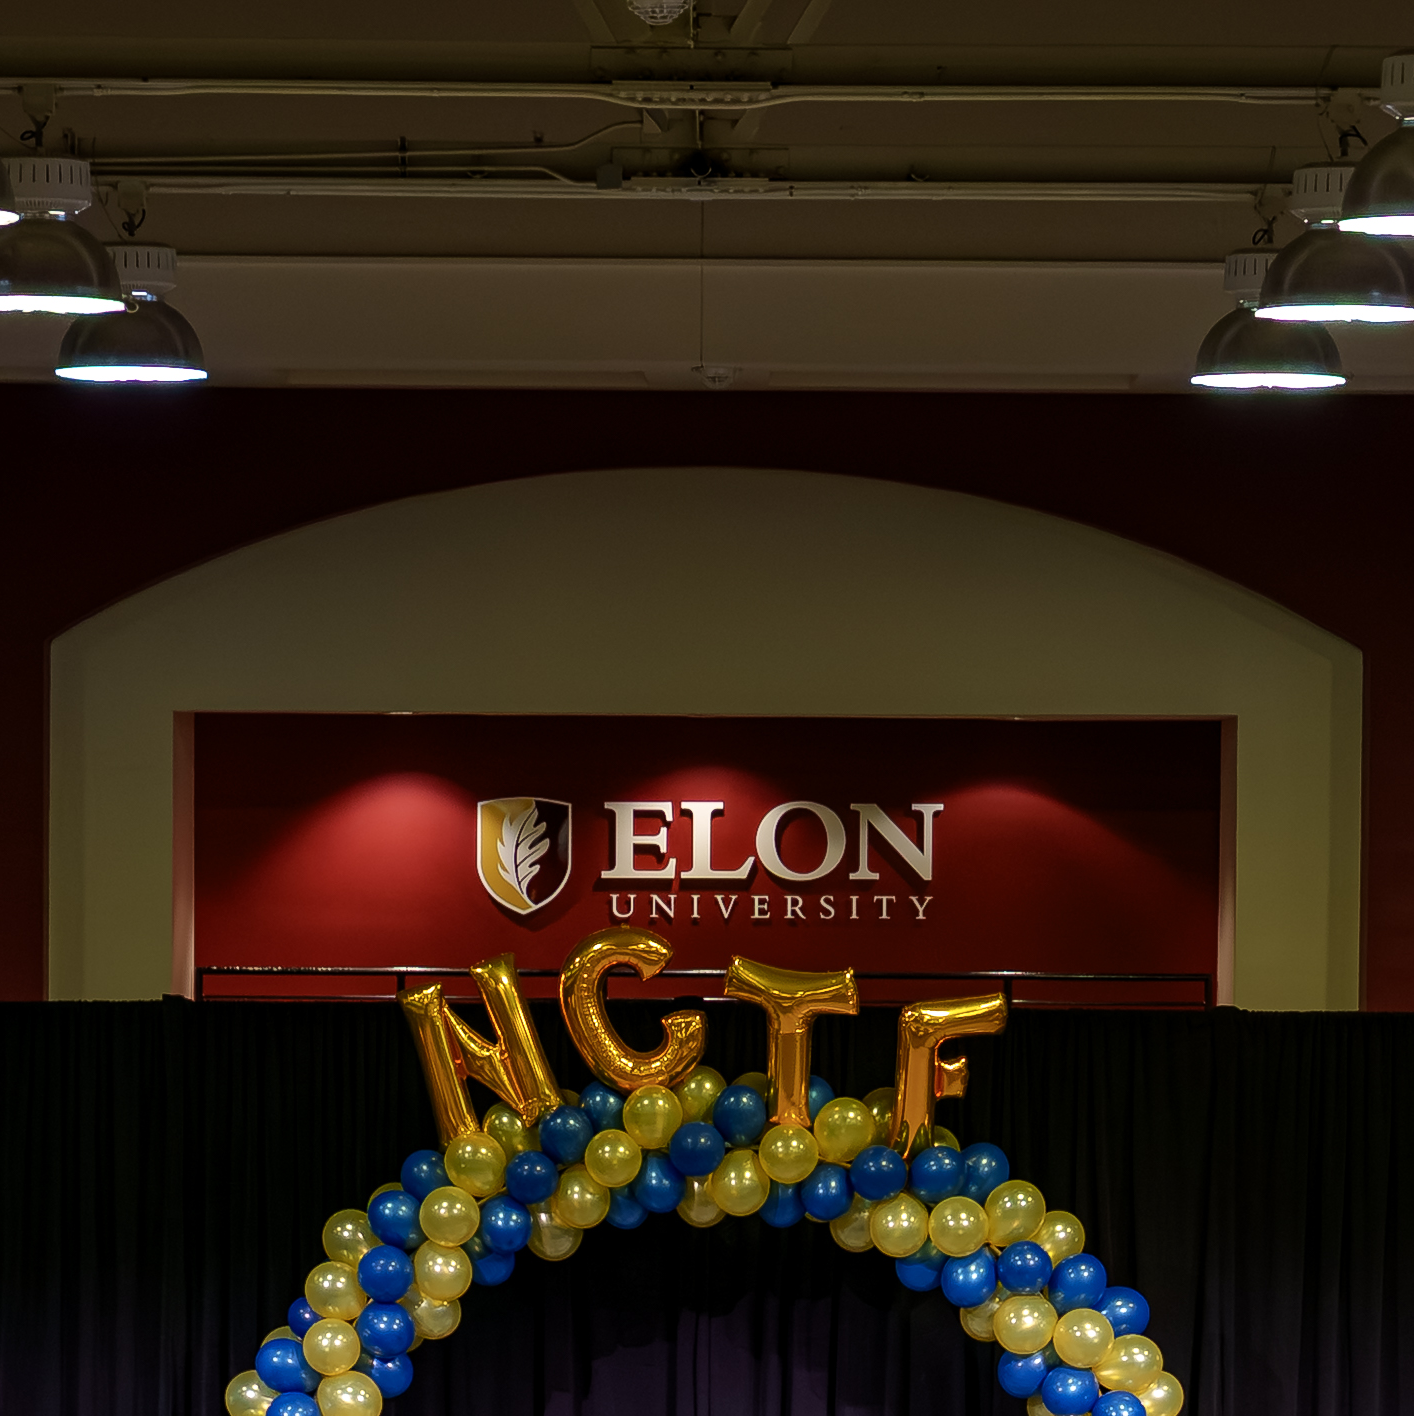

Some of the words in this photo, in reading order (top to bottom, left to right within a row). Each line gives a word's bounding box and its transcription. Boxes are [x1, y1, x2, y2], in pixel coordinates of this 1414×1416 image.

[601, 800, 944, 881] ELON
[610, 893, 935, 921] UNIVERSITY
[397, 925, 1009, 1160] NCTF
